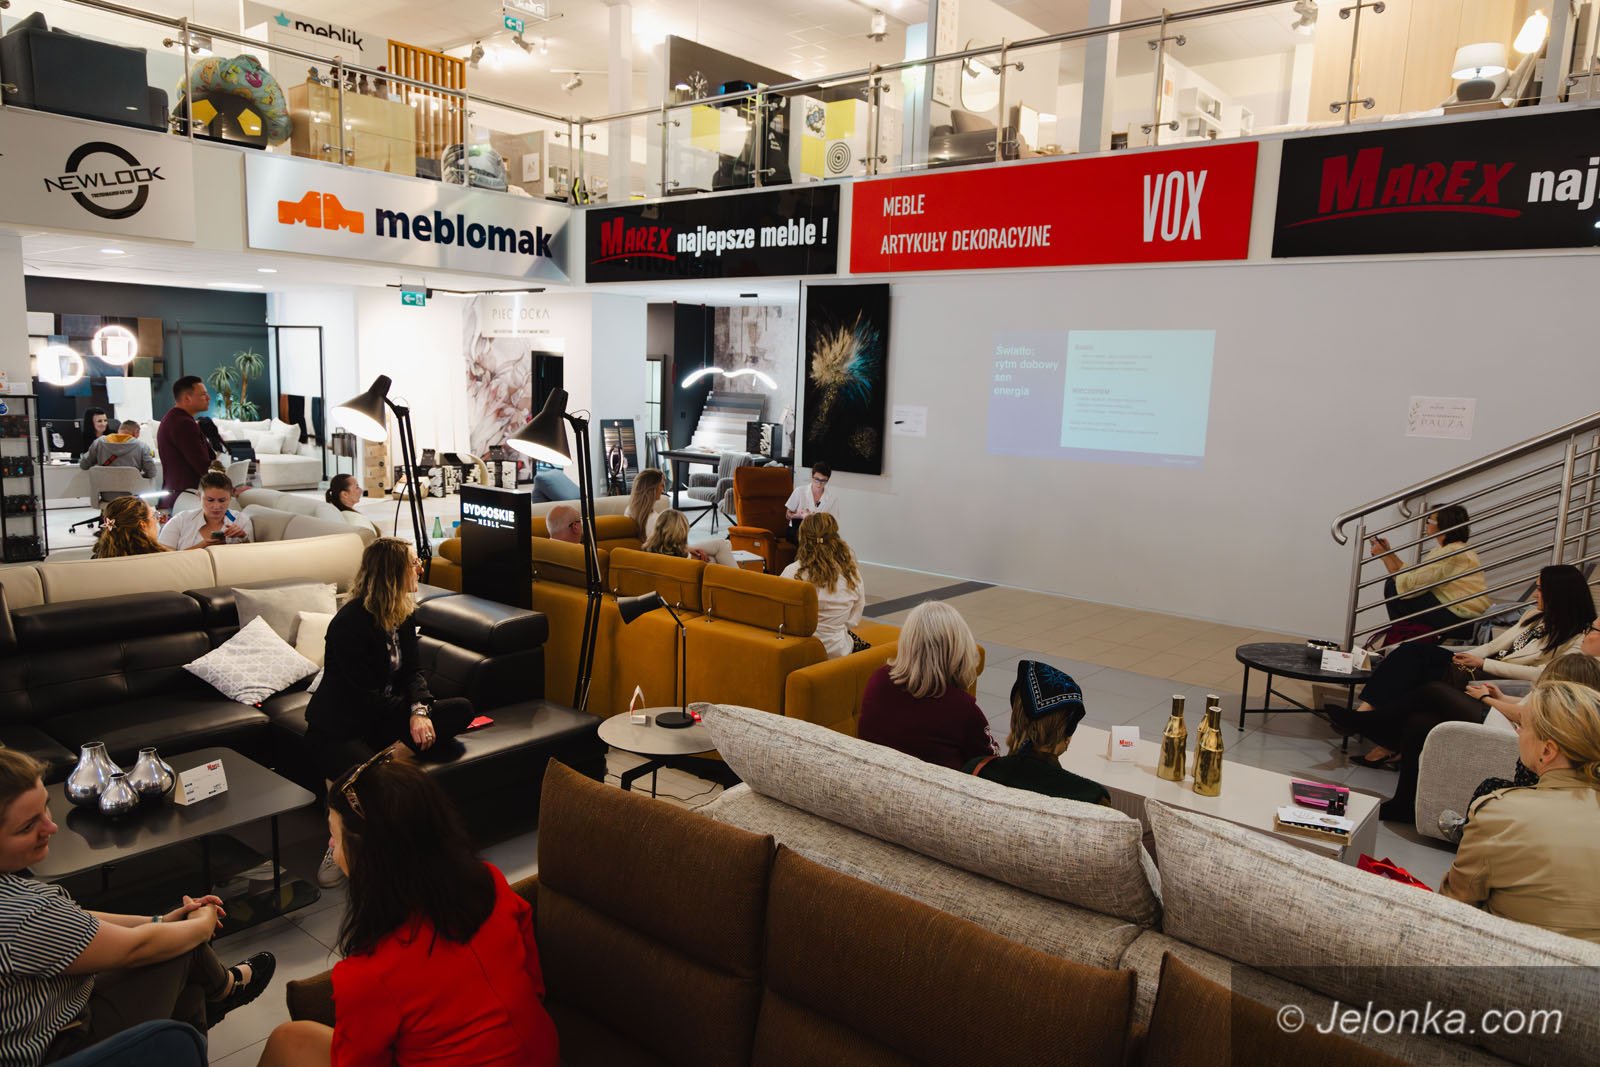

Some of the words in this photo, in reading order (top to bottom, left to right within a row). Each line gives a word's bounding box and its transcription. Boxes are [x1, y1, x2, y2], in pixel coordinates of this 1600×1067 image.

[1318, 146, 1517, 214] MAREX
[1527, 157, 1600, 211] naj
[883, 194, 925, 217] MEBLE
[1143, 170, 1208, 243] VOX
[375, 208, 553, 258] meblomak
[601, 216, 673, 257] MAREX
[677, 225, 755, 257] najlepsze
[760, 217, 816, 247] meble
[880, 231, 947, 255] ARTYKUŁY
[951, 225, 1052, 251] DEKORACYJNE
[491, 307, 550, 319] PIECOCKA
[1019, 360, 1059, 372] dobowy
[463, 502, 515, 523] BYDGOSKIE
[477, 518, 500, 528] MEBLE
